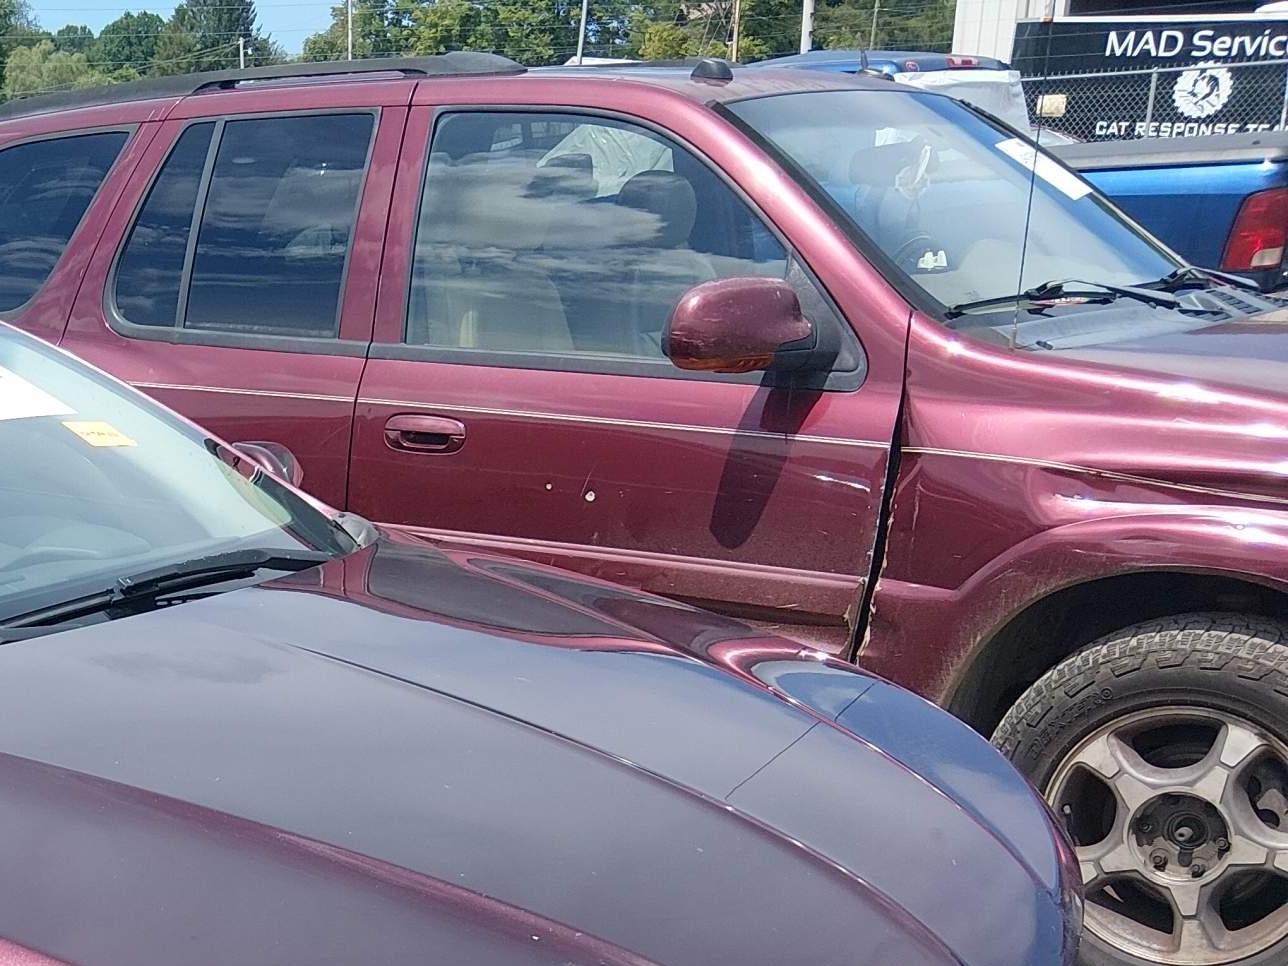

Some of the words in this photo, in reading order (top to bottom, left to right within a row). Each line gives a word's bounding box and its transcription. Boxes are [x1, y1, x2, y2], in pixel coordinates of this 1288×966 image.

[1105, 30, 1184, 57] MAD
[1190, 28, 1288, 57] Servic
[1095, 120, 1130, 136] CAT
[1134, 121, 1240, 138] RESPONSE
